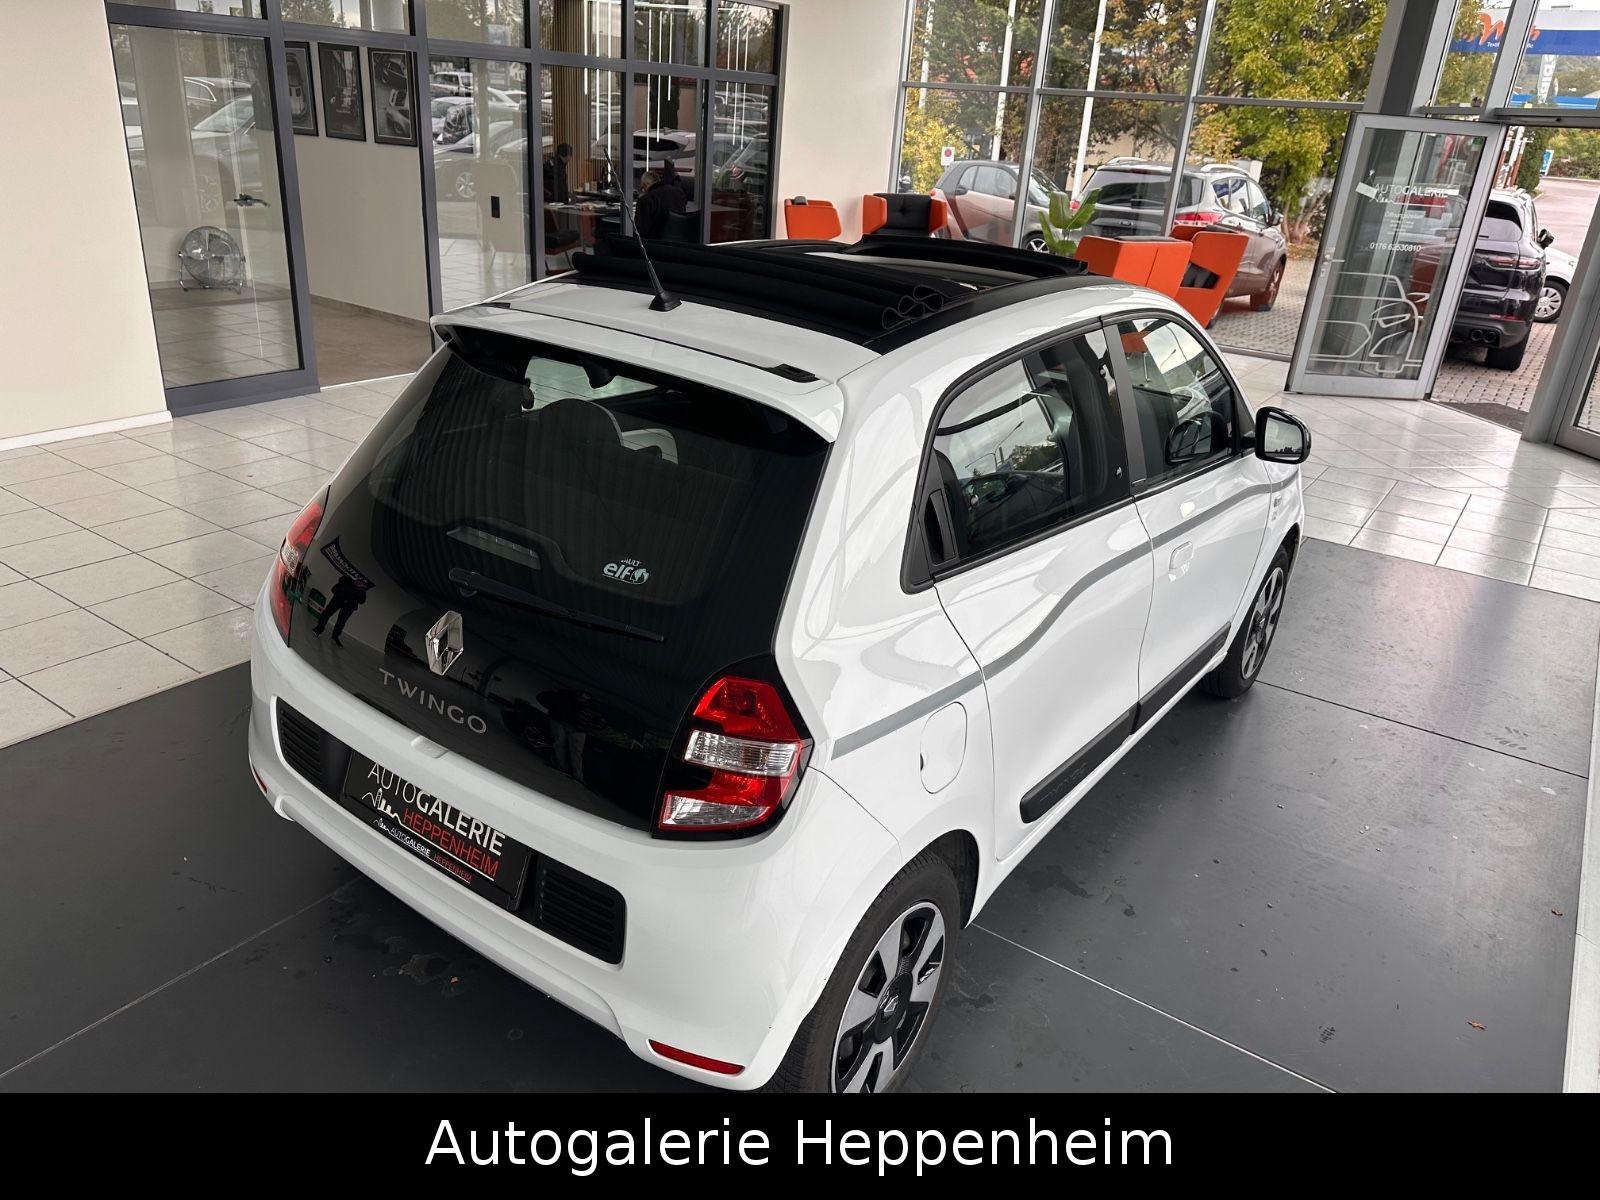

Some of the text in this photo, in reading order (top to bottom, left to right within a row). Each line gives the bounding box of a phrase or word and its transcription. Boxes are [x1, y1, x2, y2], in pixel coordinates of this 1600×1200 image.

[1375, 183, 1448, 198] AUTOGALERIE
[1369, 242, 1387, 250] 0176
[603, 563, 634, 579] elf
[379, 667, 487, 734] TWINGO
[367, 762, 506, 856] AUTOGALERIE
[391, 827, 431, 856] AUTOGALERIE
[402, 807, 500, 877] HEPPENHEIM
[434, 853, 472, 881] HEPPENHEIM
